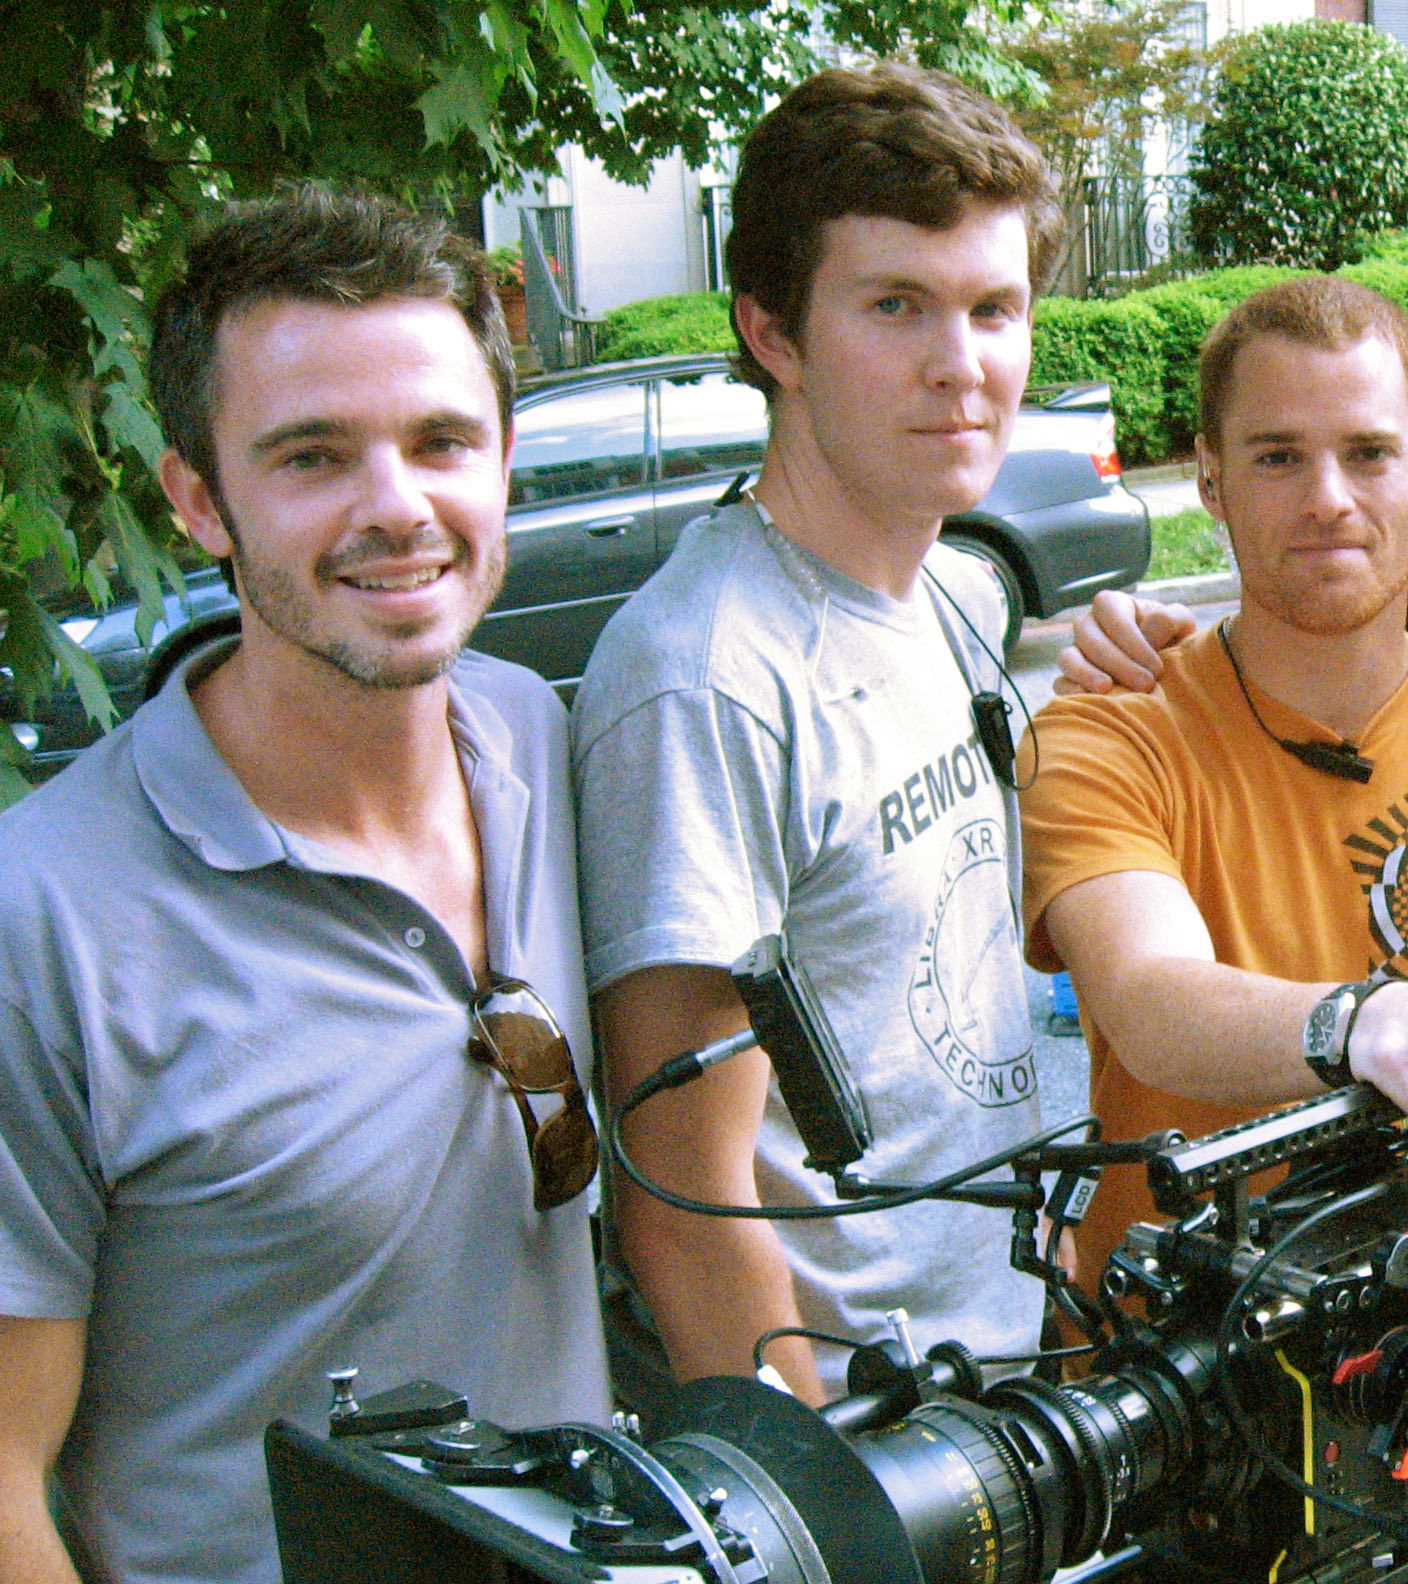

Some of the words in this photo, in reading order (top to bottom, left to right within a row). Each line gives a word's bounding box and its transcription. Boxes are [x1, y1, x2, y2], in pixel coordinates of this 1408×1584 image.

[962, 827, 994, 860] XR
[934, 1020, 1037, 1099] TECHNO
[1071, 1185, 1090, 1214] LCD
